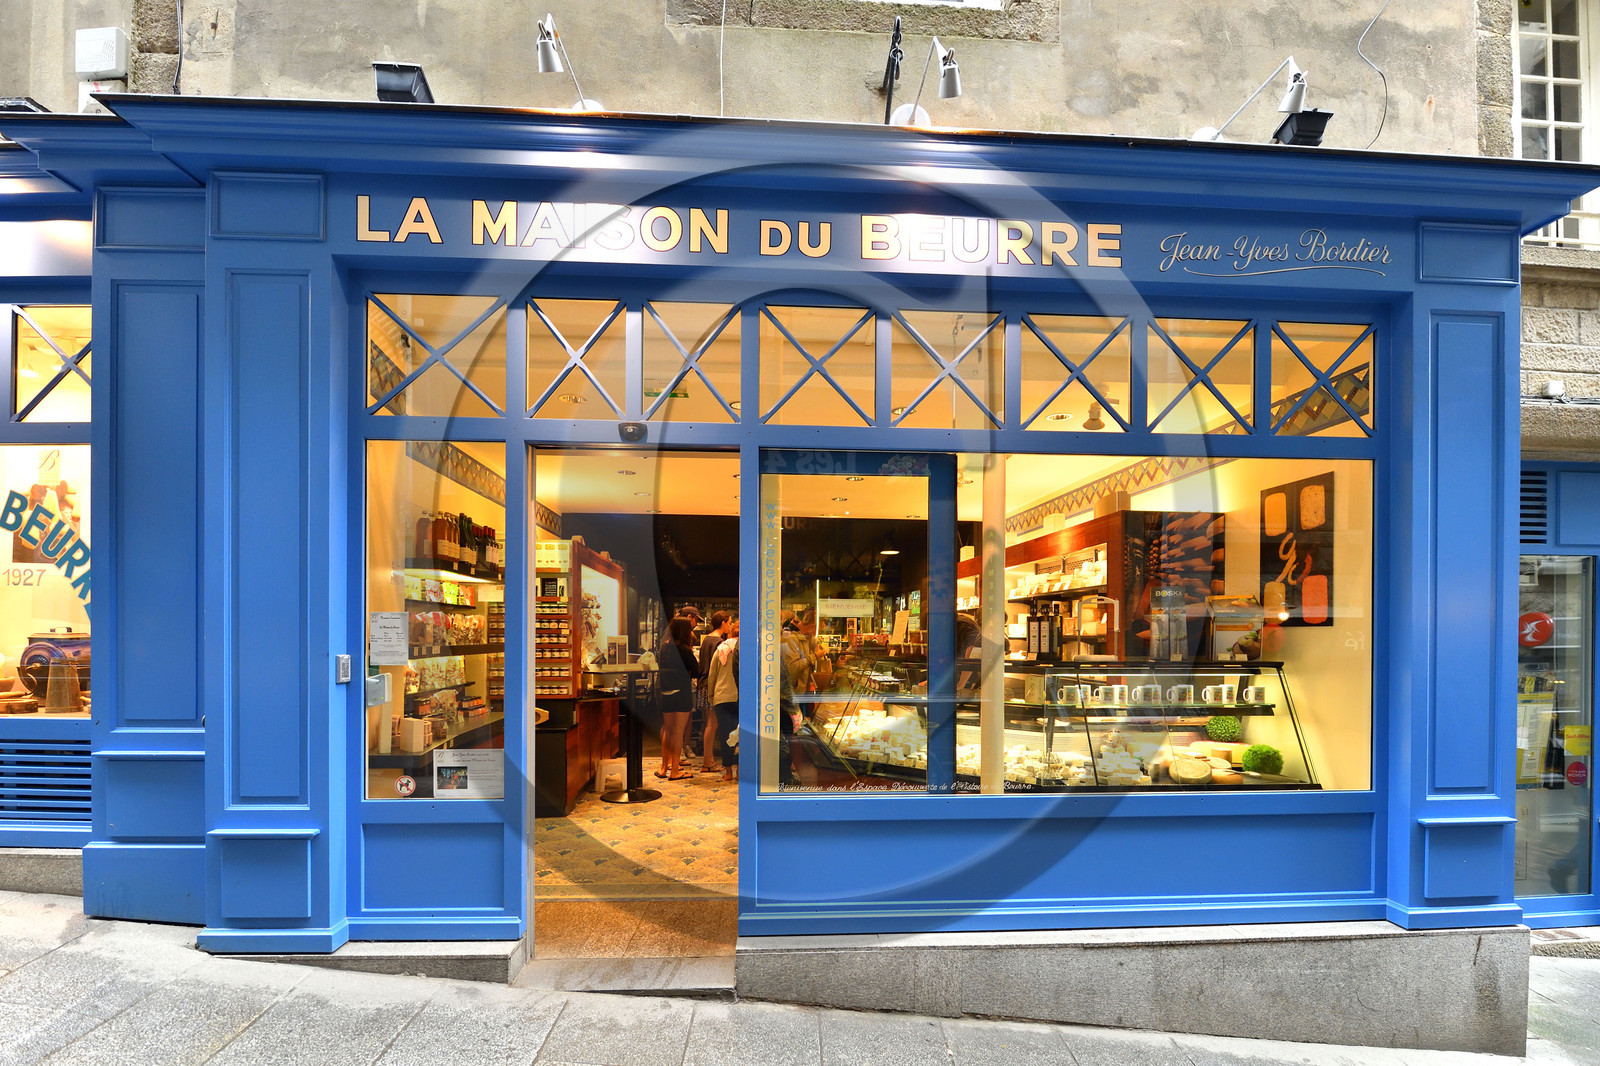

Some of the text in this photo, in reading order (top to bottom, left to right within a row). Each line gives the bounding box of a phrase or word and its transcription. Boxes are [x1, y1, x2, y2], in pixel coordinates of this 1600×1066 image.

[356, 194, 1123, 268] LA MAISON DU BEURRE
[1295, 227, 1392, 264] Bordier
[2, 568, 47, 587] 1927
[1155, 589, 1182, 597] BOSKA
[827, 783, 847, 792] dans
[939, 782, 948, 791] de
